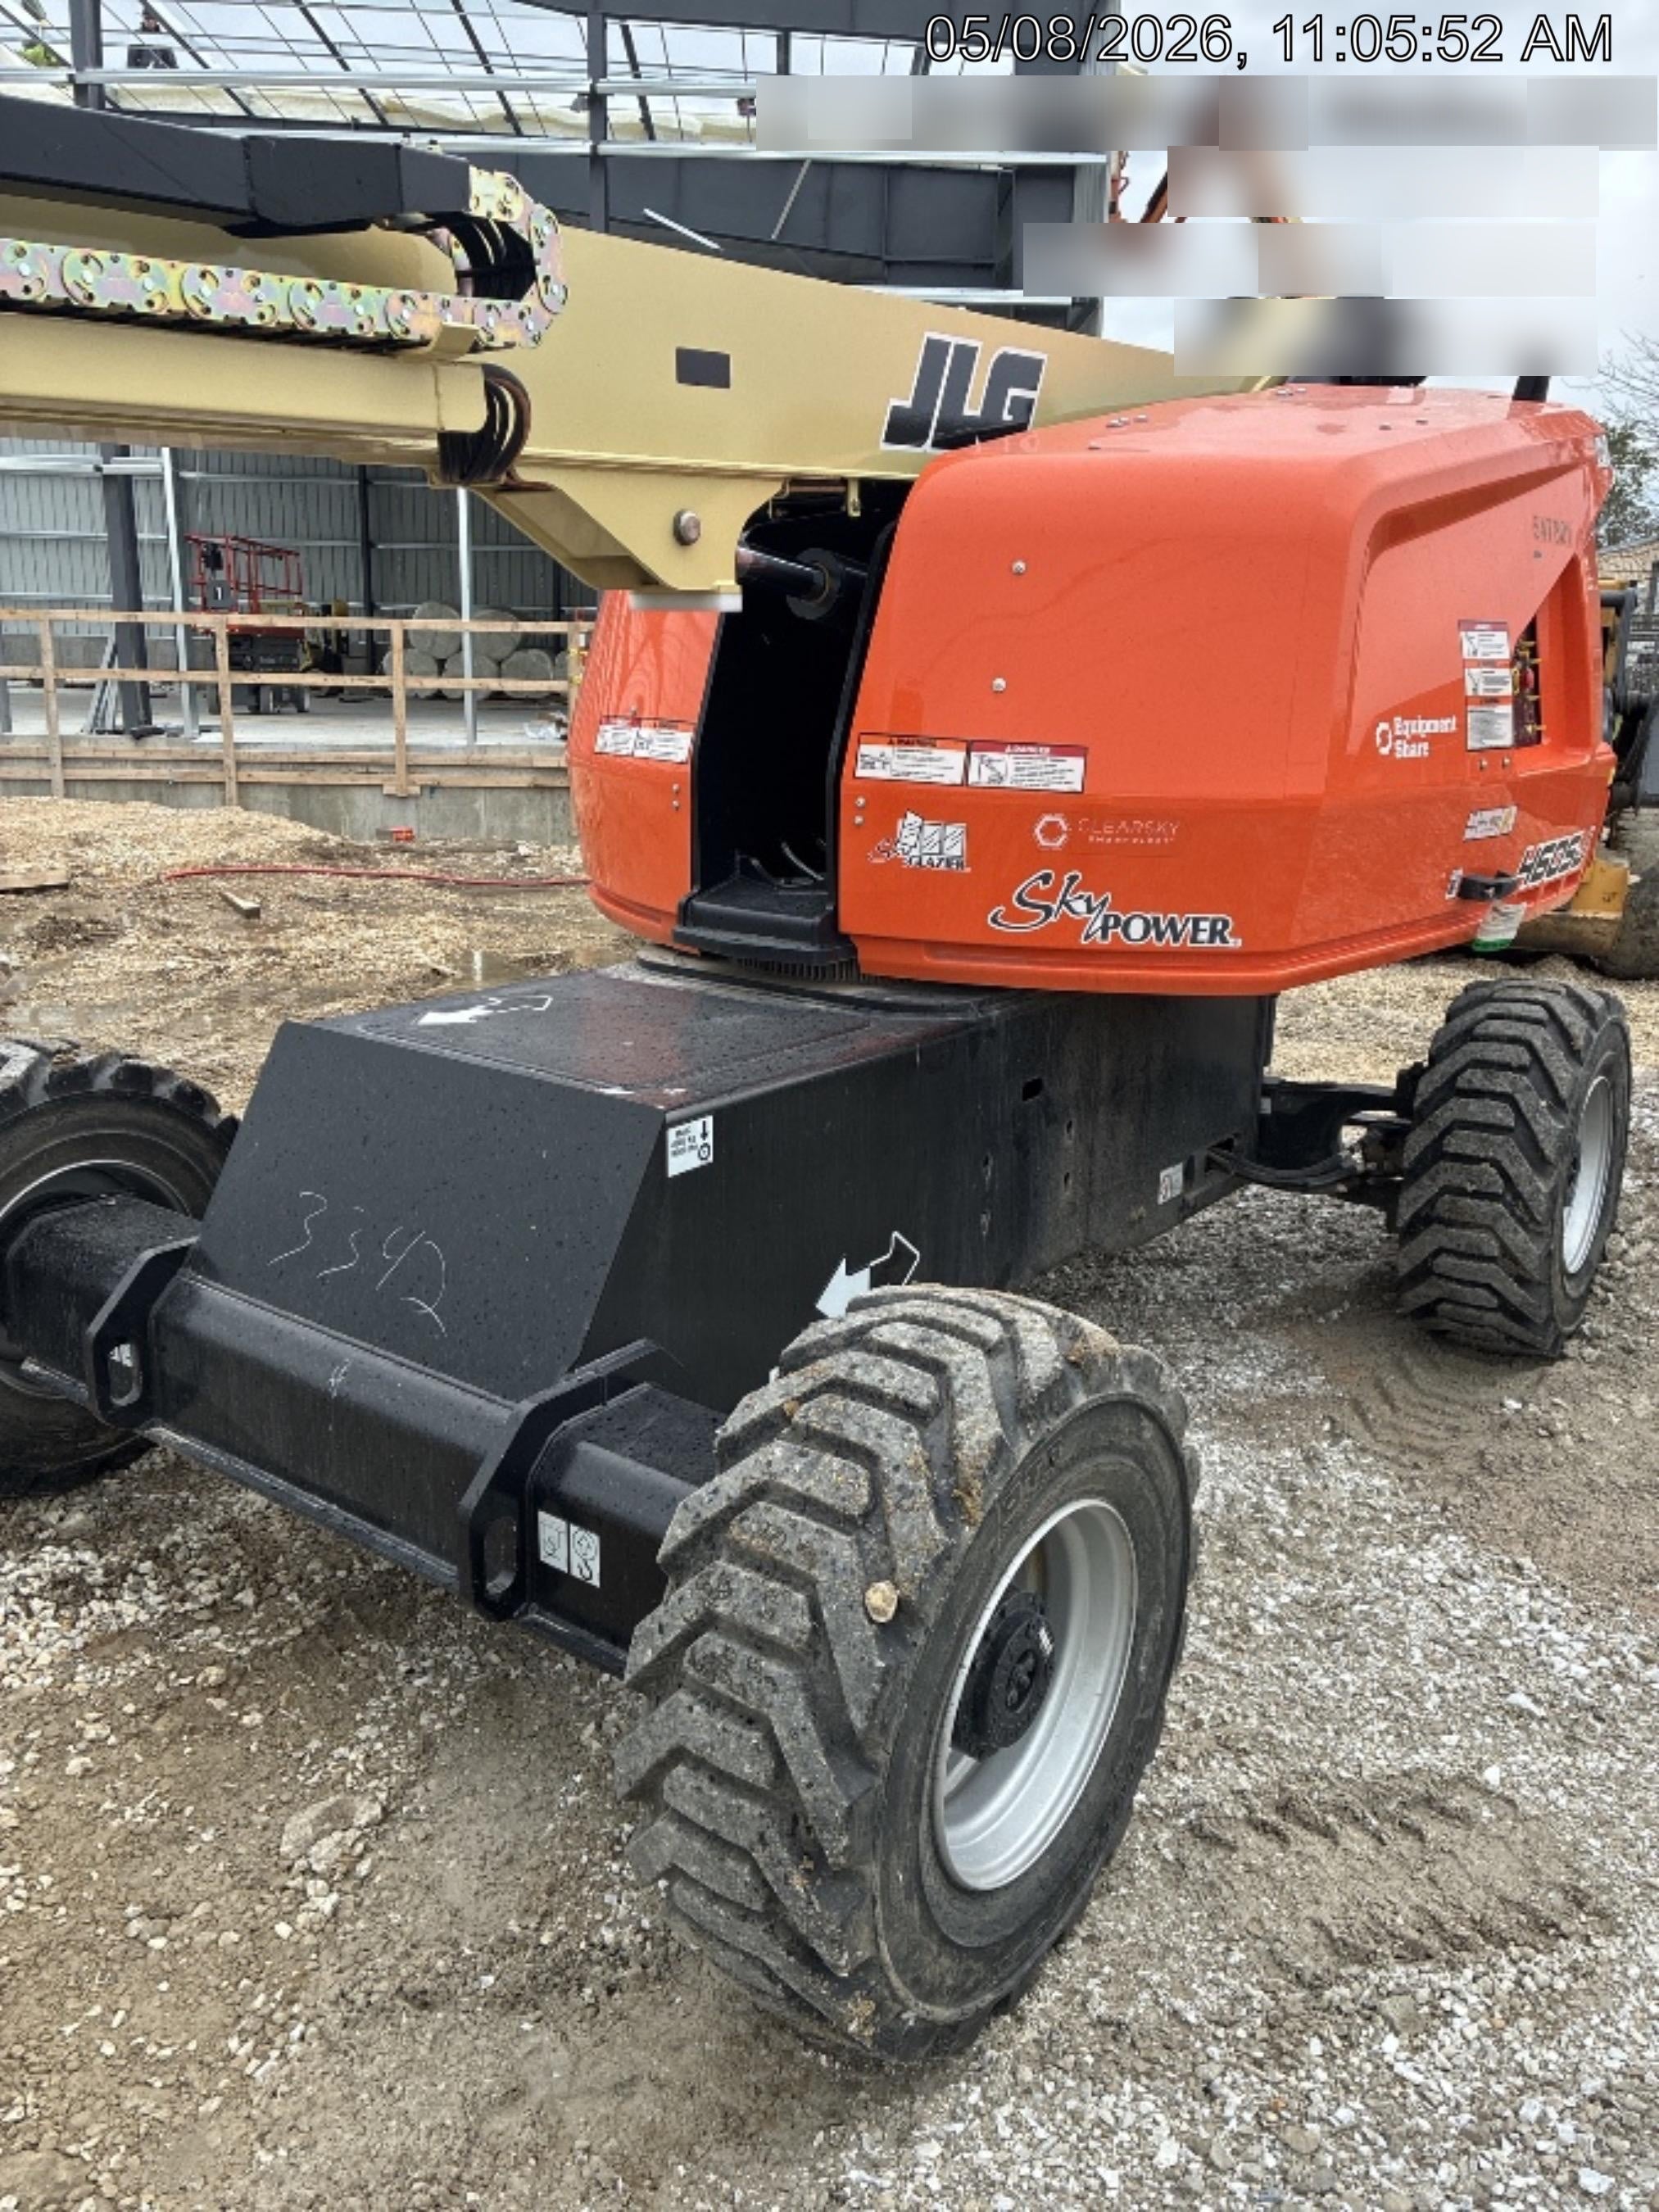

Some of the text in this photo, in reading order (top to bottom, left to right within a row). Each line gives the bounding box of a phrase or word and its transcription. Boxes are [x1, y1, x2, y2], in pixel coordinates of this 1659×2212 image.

[880, 331, 1048, 452] JLG
[215, 587, 223, 601] 1
[1394, 714, 1457, 739] Equipment
[1394, 739, 1430, 759] Share
